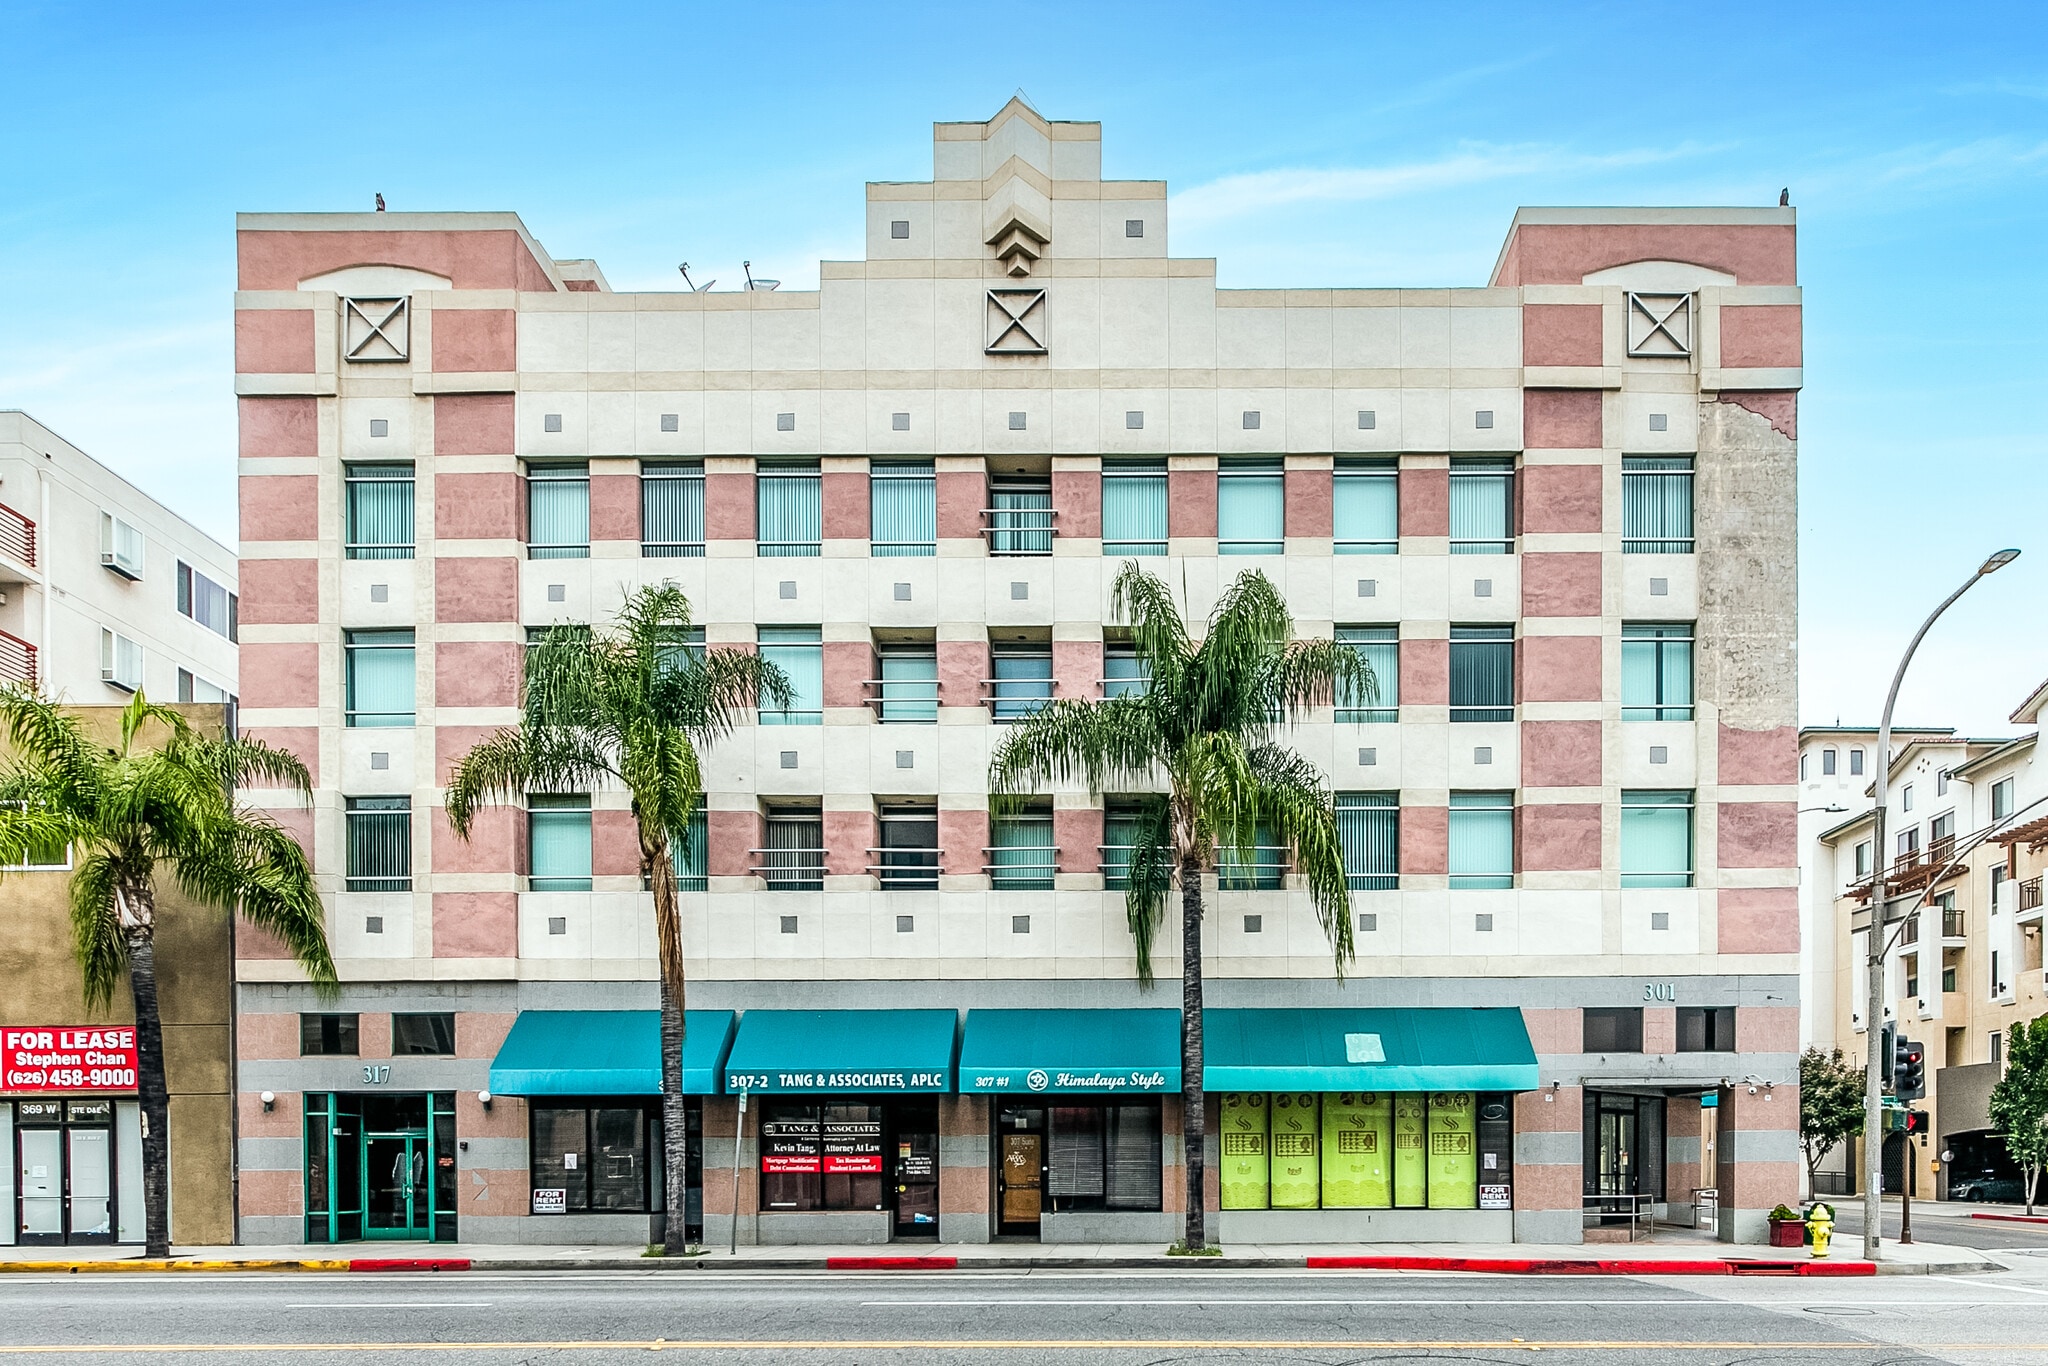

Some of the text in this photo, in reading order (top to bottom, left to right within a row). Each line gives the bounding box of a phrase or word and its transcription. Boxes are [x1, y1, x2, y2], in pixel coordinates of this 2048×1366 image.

[1643, 982, 1676, 1002] 301
[7, 1031, 134, 1049] FOR LEASE
[15, 1051, 126, 1068] Stephen Chan
[7, 1069, 135, 1087] (626) 458-9000
[363, 1065, 391, 1084] 317
[730, 1073, 942, 1089] 307-2 TANG & ASSOCIATES, APLC
[975, 1077, 1010, 1087] 307 #1
[1054, 1071, 1165, 1090] Himalaya Style
[22, 1104, 57, 1114] 369 W
[780, 1125, 880, 1133] TANG & ASSOCIATES
[774, 1143, 795, 1152] Kevin
[825, 1143, 854, 1154] Attorney
[855, 1143, 864, 1152] At
[865, 1143, 880, 1152] Law
